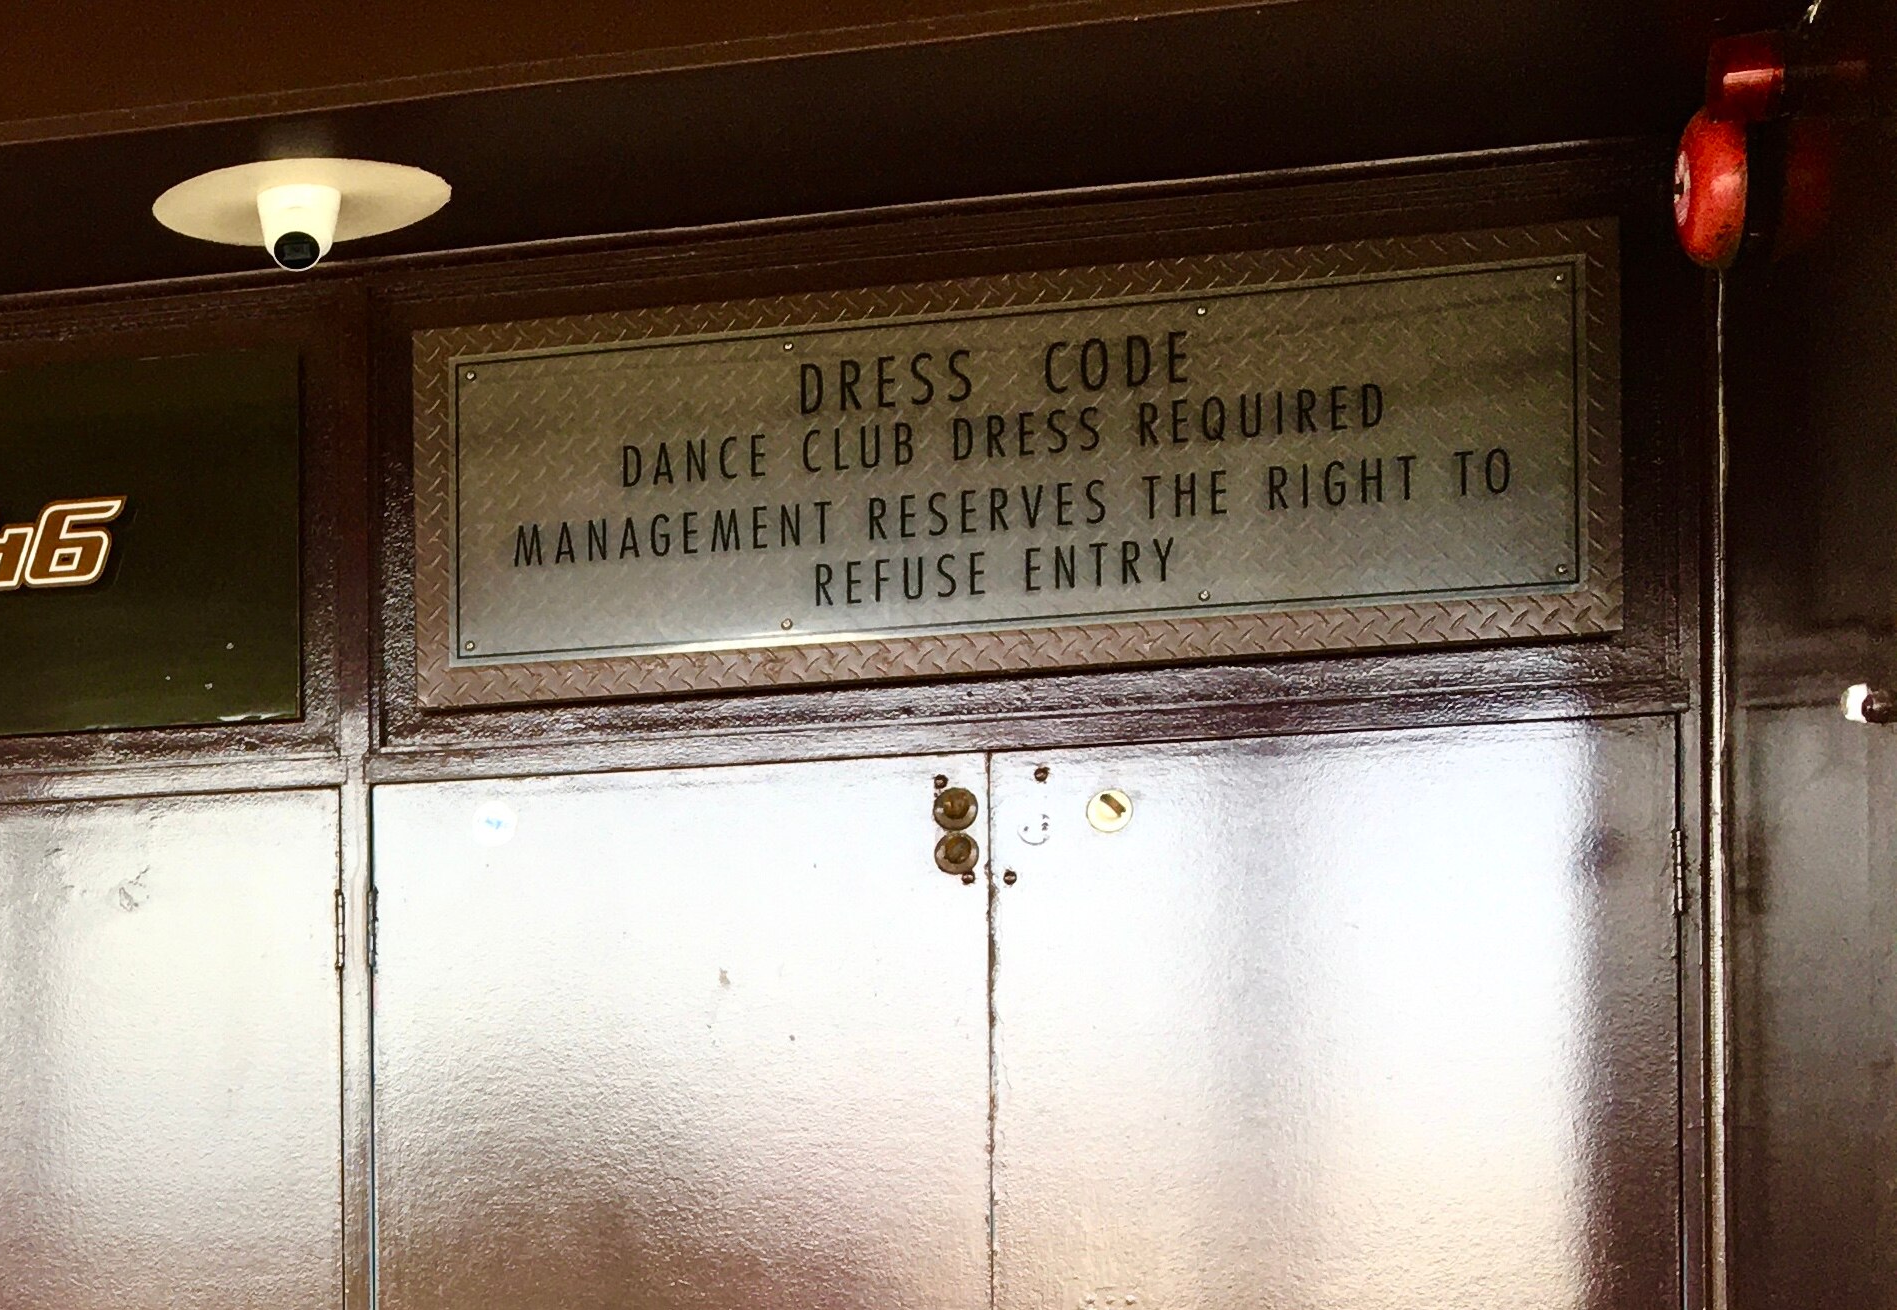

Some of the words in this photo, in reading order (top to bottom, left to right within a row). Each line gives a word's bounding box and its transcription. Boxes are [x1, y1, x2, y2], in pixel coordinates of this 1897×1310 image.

[799, 349, 974, 415] DRESS
[1044, 330, 1189, 395] CODE
[621, 433, 767, 489] DANCE
[802, 422, 914, 473] CLUB
[952, 406, 1101, 462] DRESS
[1138, 383, 1385, 447] REQUIRED
[513, 500, 833, 568] MANAGEMENT
[867, 479, 1107, 541] RESERVES
[1141, 469, 1229, 520] THE
[1267, 455, 1417, 511] RIGHT
[1453, 447, 1512, 498] TO
[814, 551, 987, 607] REFUSE
[1024, 536, 1175, 593] ENTRY
